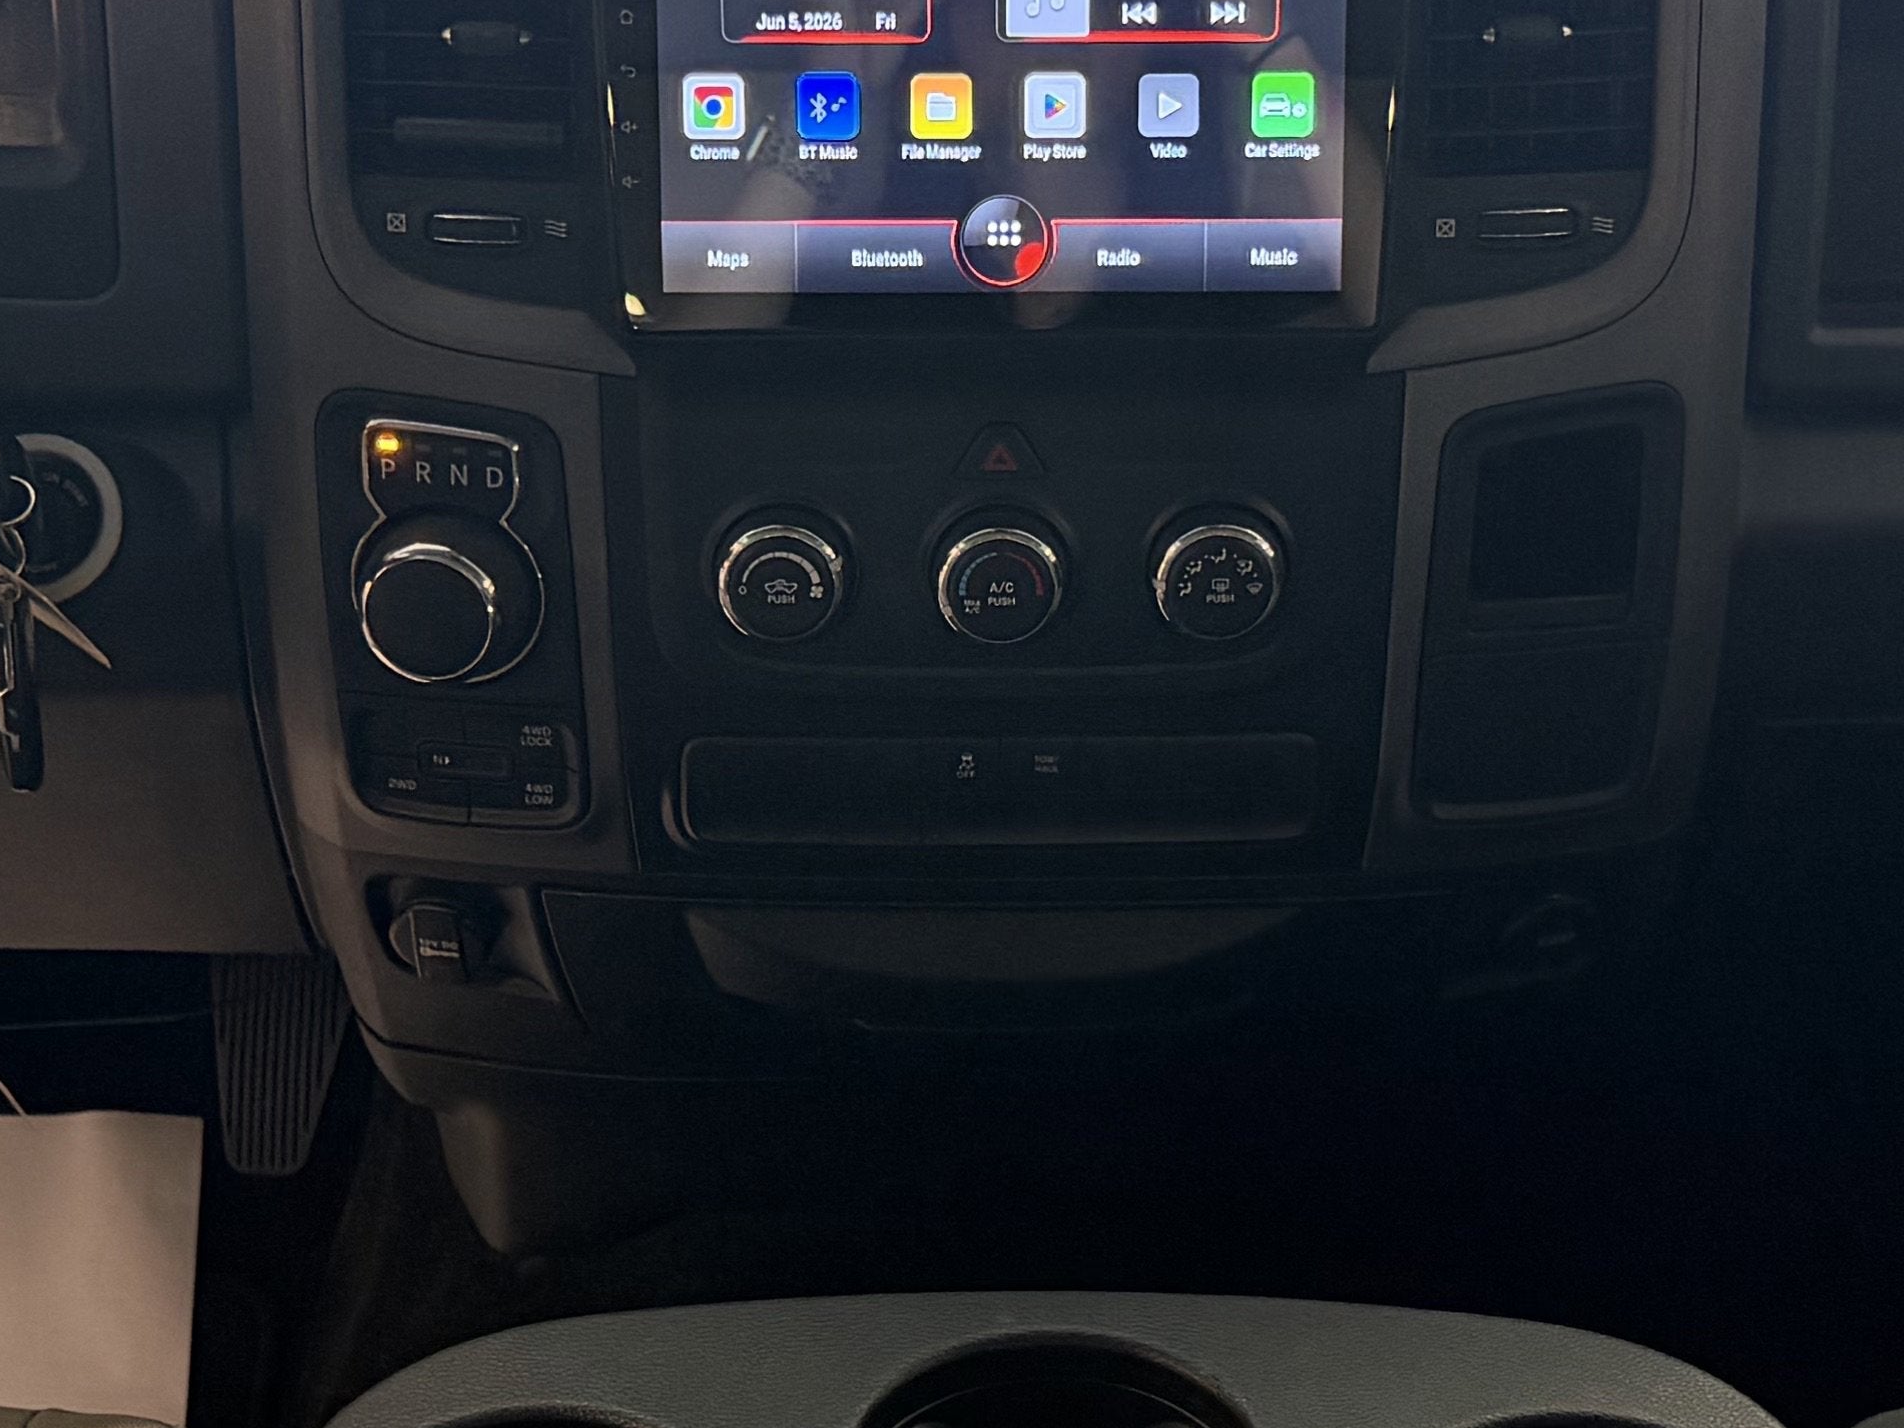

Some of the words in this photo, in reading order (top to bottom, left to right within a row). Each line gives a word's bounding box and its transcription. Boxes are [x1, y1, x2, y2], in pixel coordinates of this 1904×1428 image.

[755, 12, 786, 32] Jun
[788, 13, 803, 34] 5,
[804, 12, 843, 31] 2026
[875, 12, 897, 31] Fri
[689, 144, 741, 160] Chrome
[799, 145, 818, 160] BT
[819, 145, 858, 161] Music
[901, 144, 924, 160] File
[925, 145, 982, 163] Manager
[1022, 143, 1052, 162] Play
[1052, 143, 1087, 160] Store
[1149, 143, 1188, 160] Video
[1244, 143, 1267, 159] Car
[1268, 143, 1321, 162] Settings
[707, 249, 750, 271] Maps
[851, 248, 924, 268] Bluetooth
[1096, 248, 1142, 268] Radio
[1249, 247, 1299, 267] Music
[380, 458, 396, 480] P
[415, 461, 432, 485] R
[450, 463, 469, 487] N
[485, 466, 504, 489] D
[989, 581, 1014, 594] A/C
[766, 594, 796, 604] PUSH
[987, 596, 1016, 607] PUSH
[1206, 594, 1235, 604] PUSH
[521, 725, 552, 738] 4WD
[520, 735, 553, 747] LOCK
[525, 782, 554, 795] 4WD
[524, 793, 554, 805] LOW
